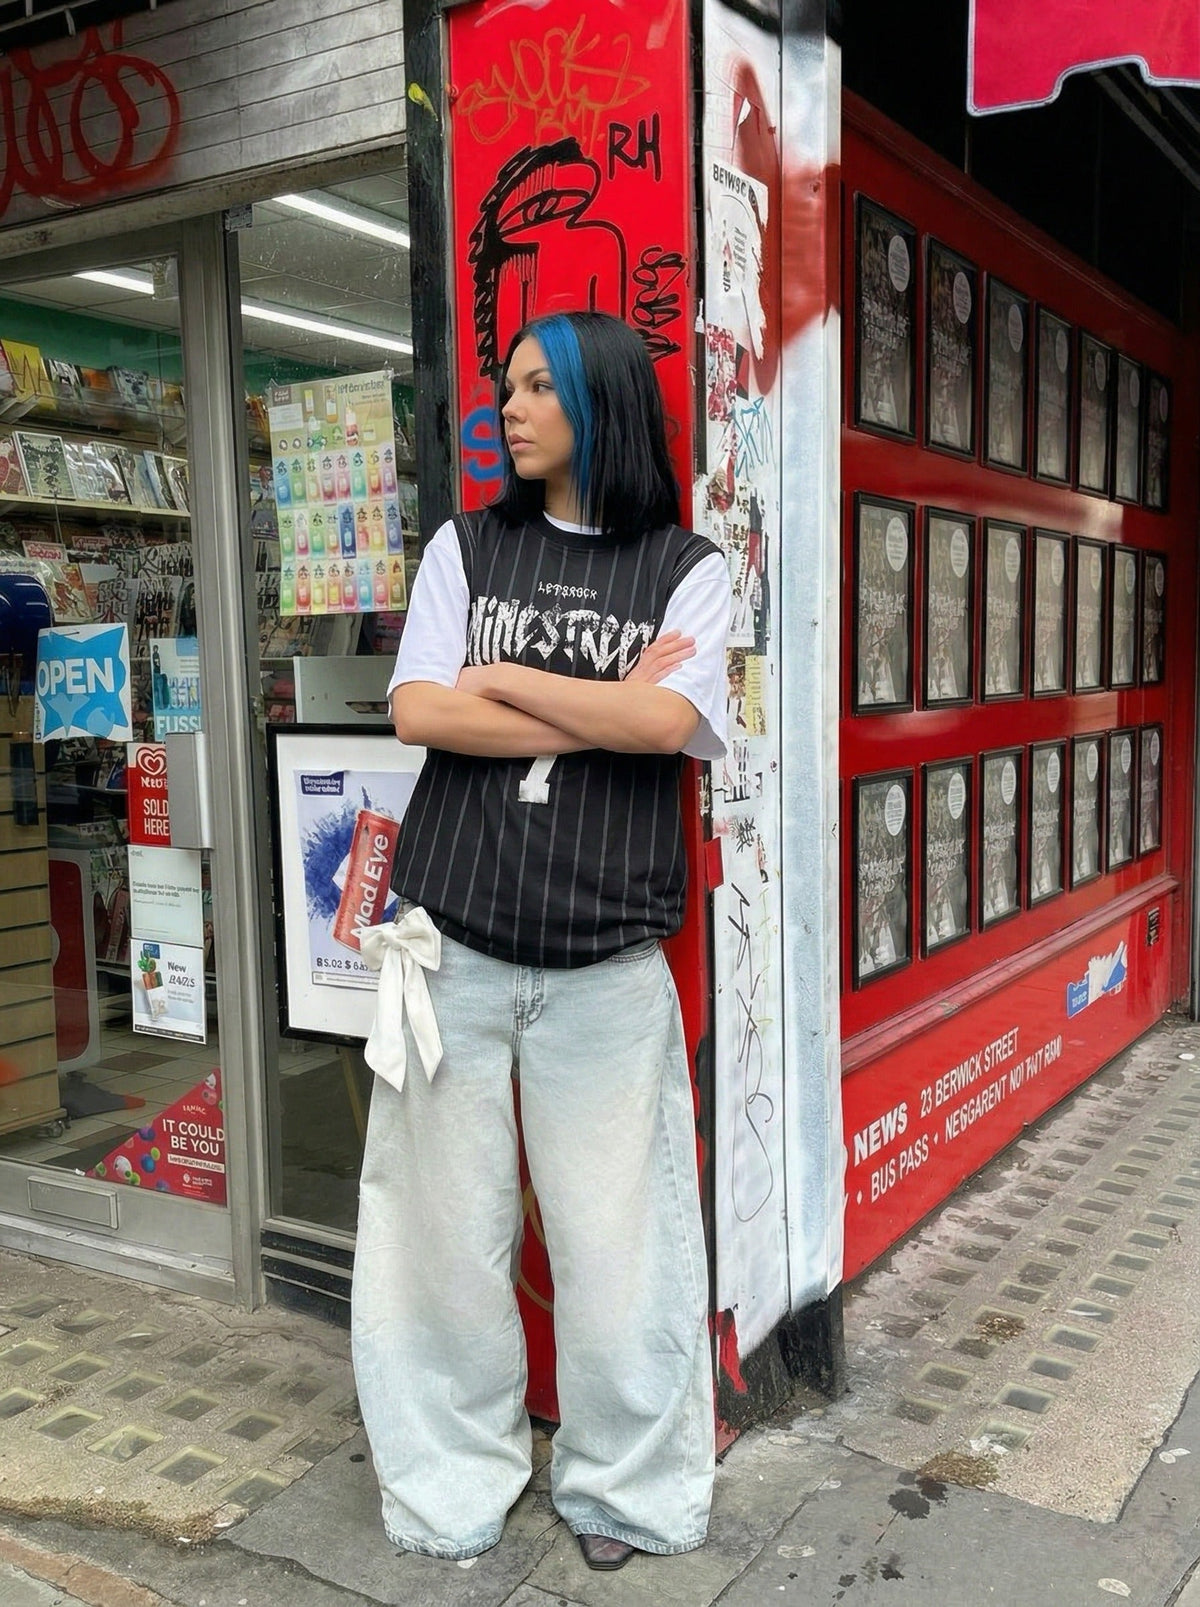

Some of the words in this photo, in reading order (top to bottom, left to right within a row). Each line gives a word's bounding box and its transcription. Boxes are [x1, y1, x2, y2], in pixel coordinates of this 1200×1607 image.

[609, 112, 662, 182] RH
[37, 658, 115, 697] OPEN
[143, 798, 169, 817] SOLD
[144, 817, 169, 837] HERE
[350, 881, 378, 940] Mad
[364, 834, 389, 882] Eye
[167, 961, 187, 973] New
[854, 1102, 908, 1167] NEWS
[920, 1086, 932, 1119] 23
[935, 1050, 983, 1108] BERWICK
[984, 1026, 1019, 1073] STREET
[162, 1118, 175, 1133] IT
[178, 1121, 224, 1142] COULD
[170, 1135, 188, 1151] BE
[190, 1138, 219, 1156] YOU
[871, 1158, 896, 1203] BUS
[899, 1133, 929, 1180] PASS
